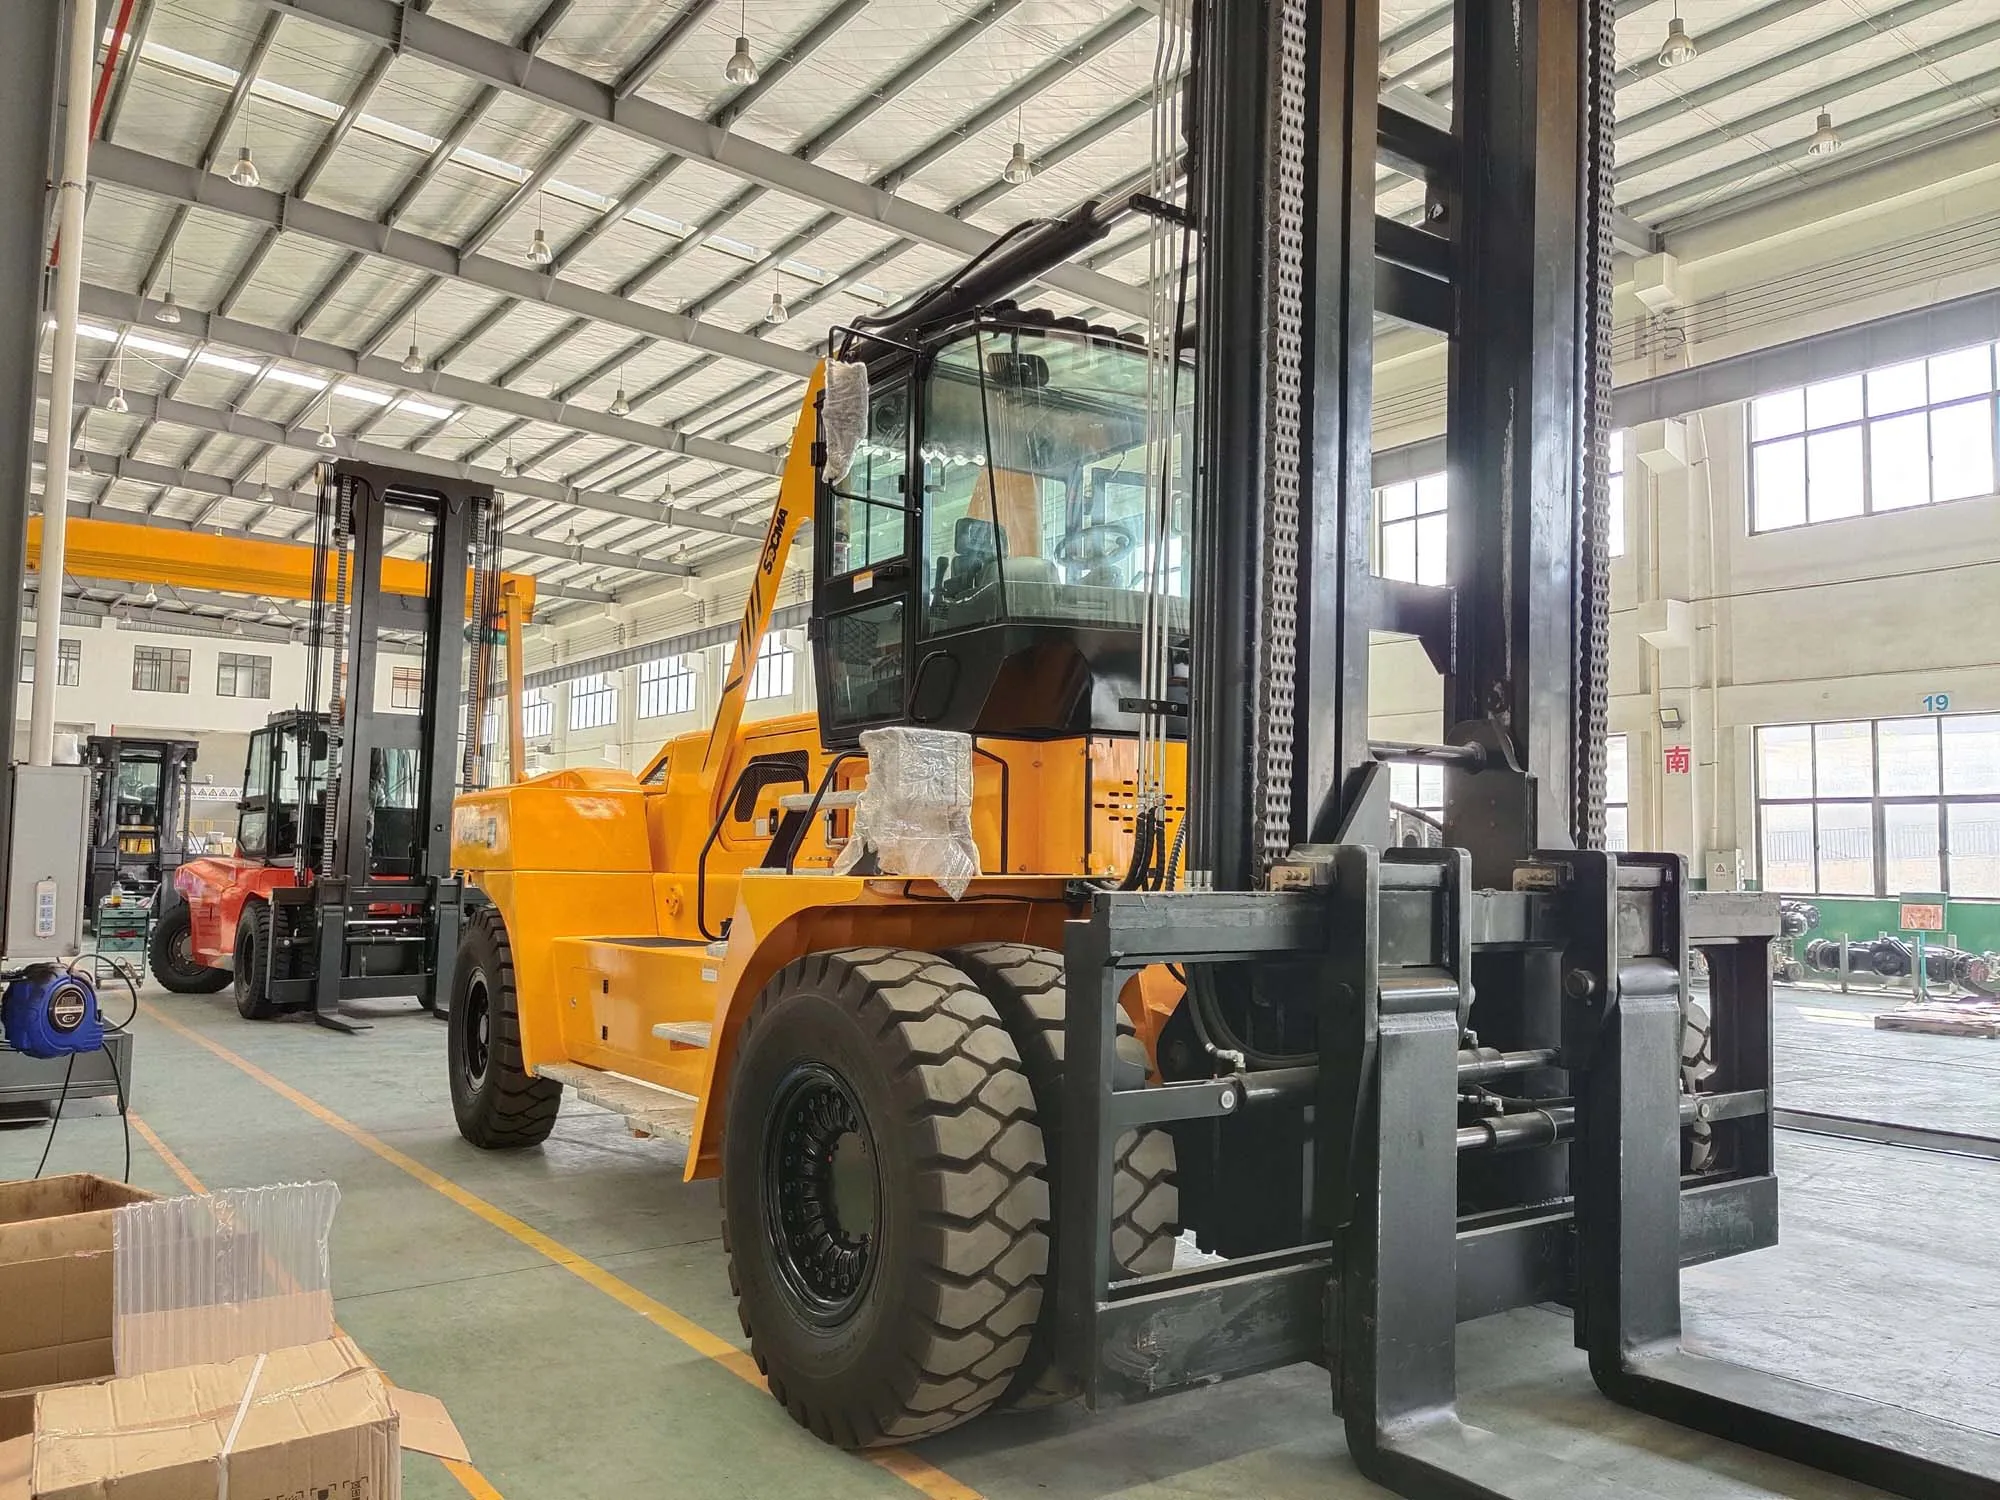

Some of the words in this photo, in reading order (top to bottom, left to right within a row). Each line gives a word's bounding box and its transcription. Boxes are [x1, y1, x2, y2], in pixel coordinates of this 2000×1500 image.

[763, 508, 788, 575] SOCMA
[1922, 694, 1949, 712] 19
[1664, 745, 1691, 774] 南
